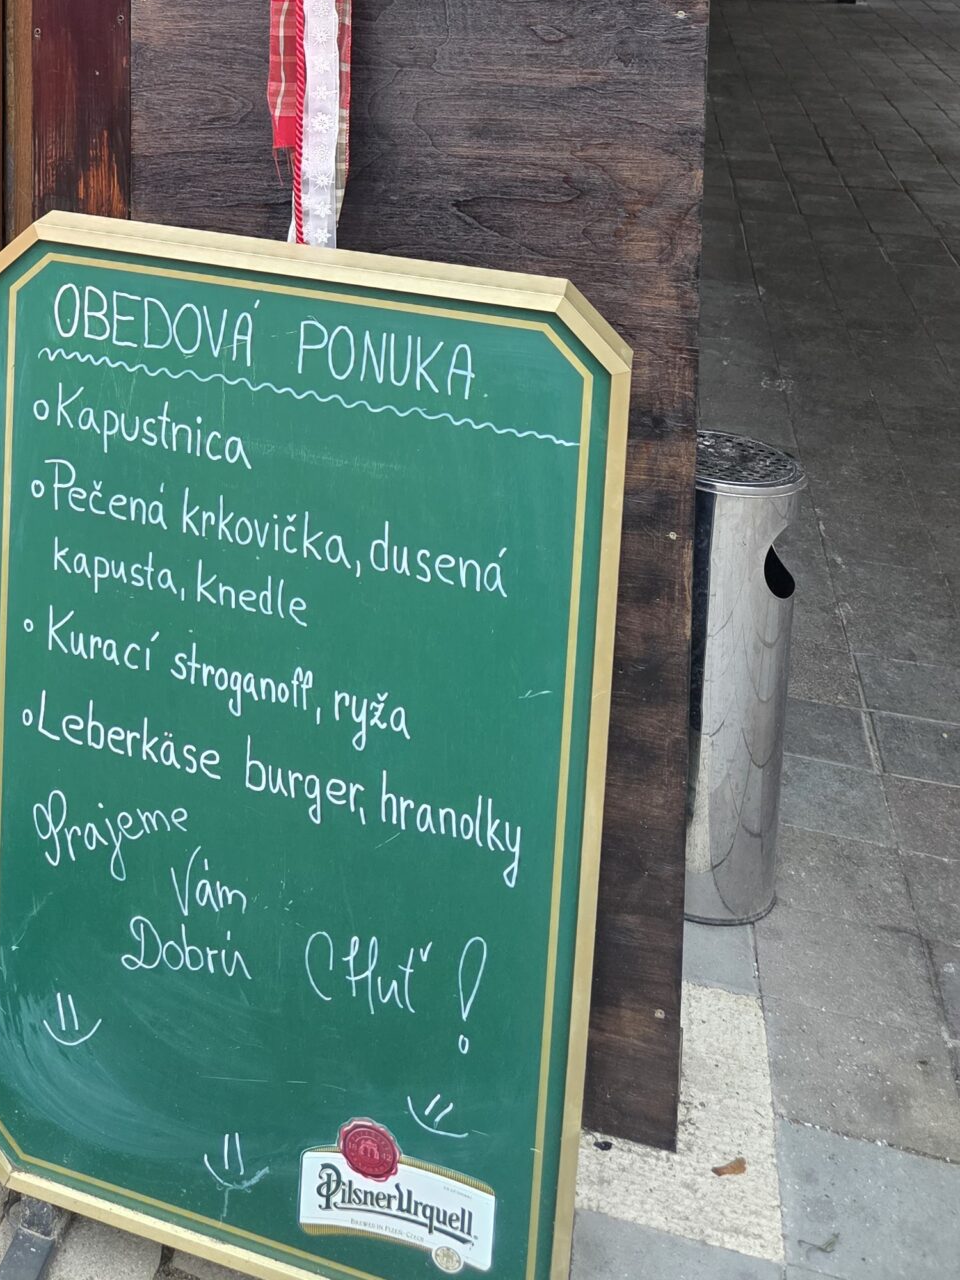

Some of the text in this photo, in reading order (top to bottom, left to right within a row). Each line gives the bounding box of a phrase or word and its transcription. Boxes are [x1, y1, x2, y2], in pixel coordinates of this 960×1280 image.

[54, 283, 475, 400] OBEDOVÁ PONUKA
[56, 382, 252, 470] Kapustnica
[44, 458, 508, 598] Pečená krkovička, dusená
[54, 536, 307, 627] kapusta, knedle
[48, 605, 160, 671] Kurací
[334, 691, 411, 752] ryža
[38, 690, 522, 888] Leberkäse burger, hranolky
[33, 790, 188, 882] Prajeme
[170, 846, 247, 916] Vám
[121, 916, 252, 980] Dobrú
[316, 1163, 473, 1236] Pilsner Urquell
